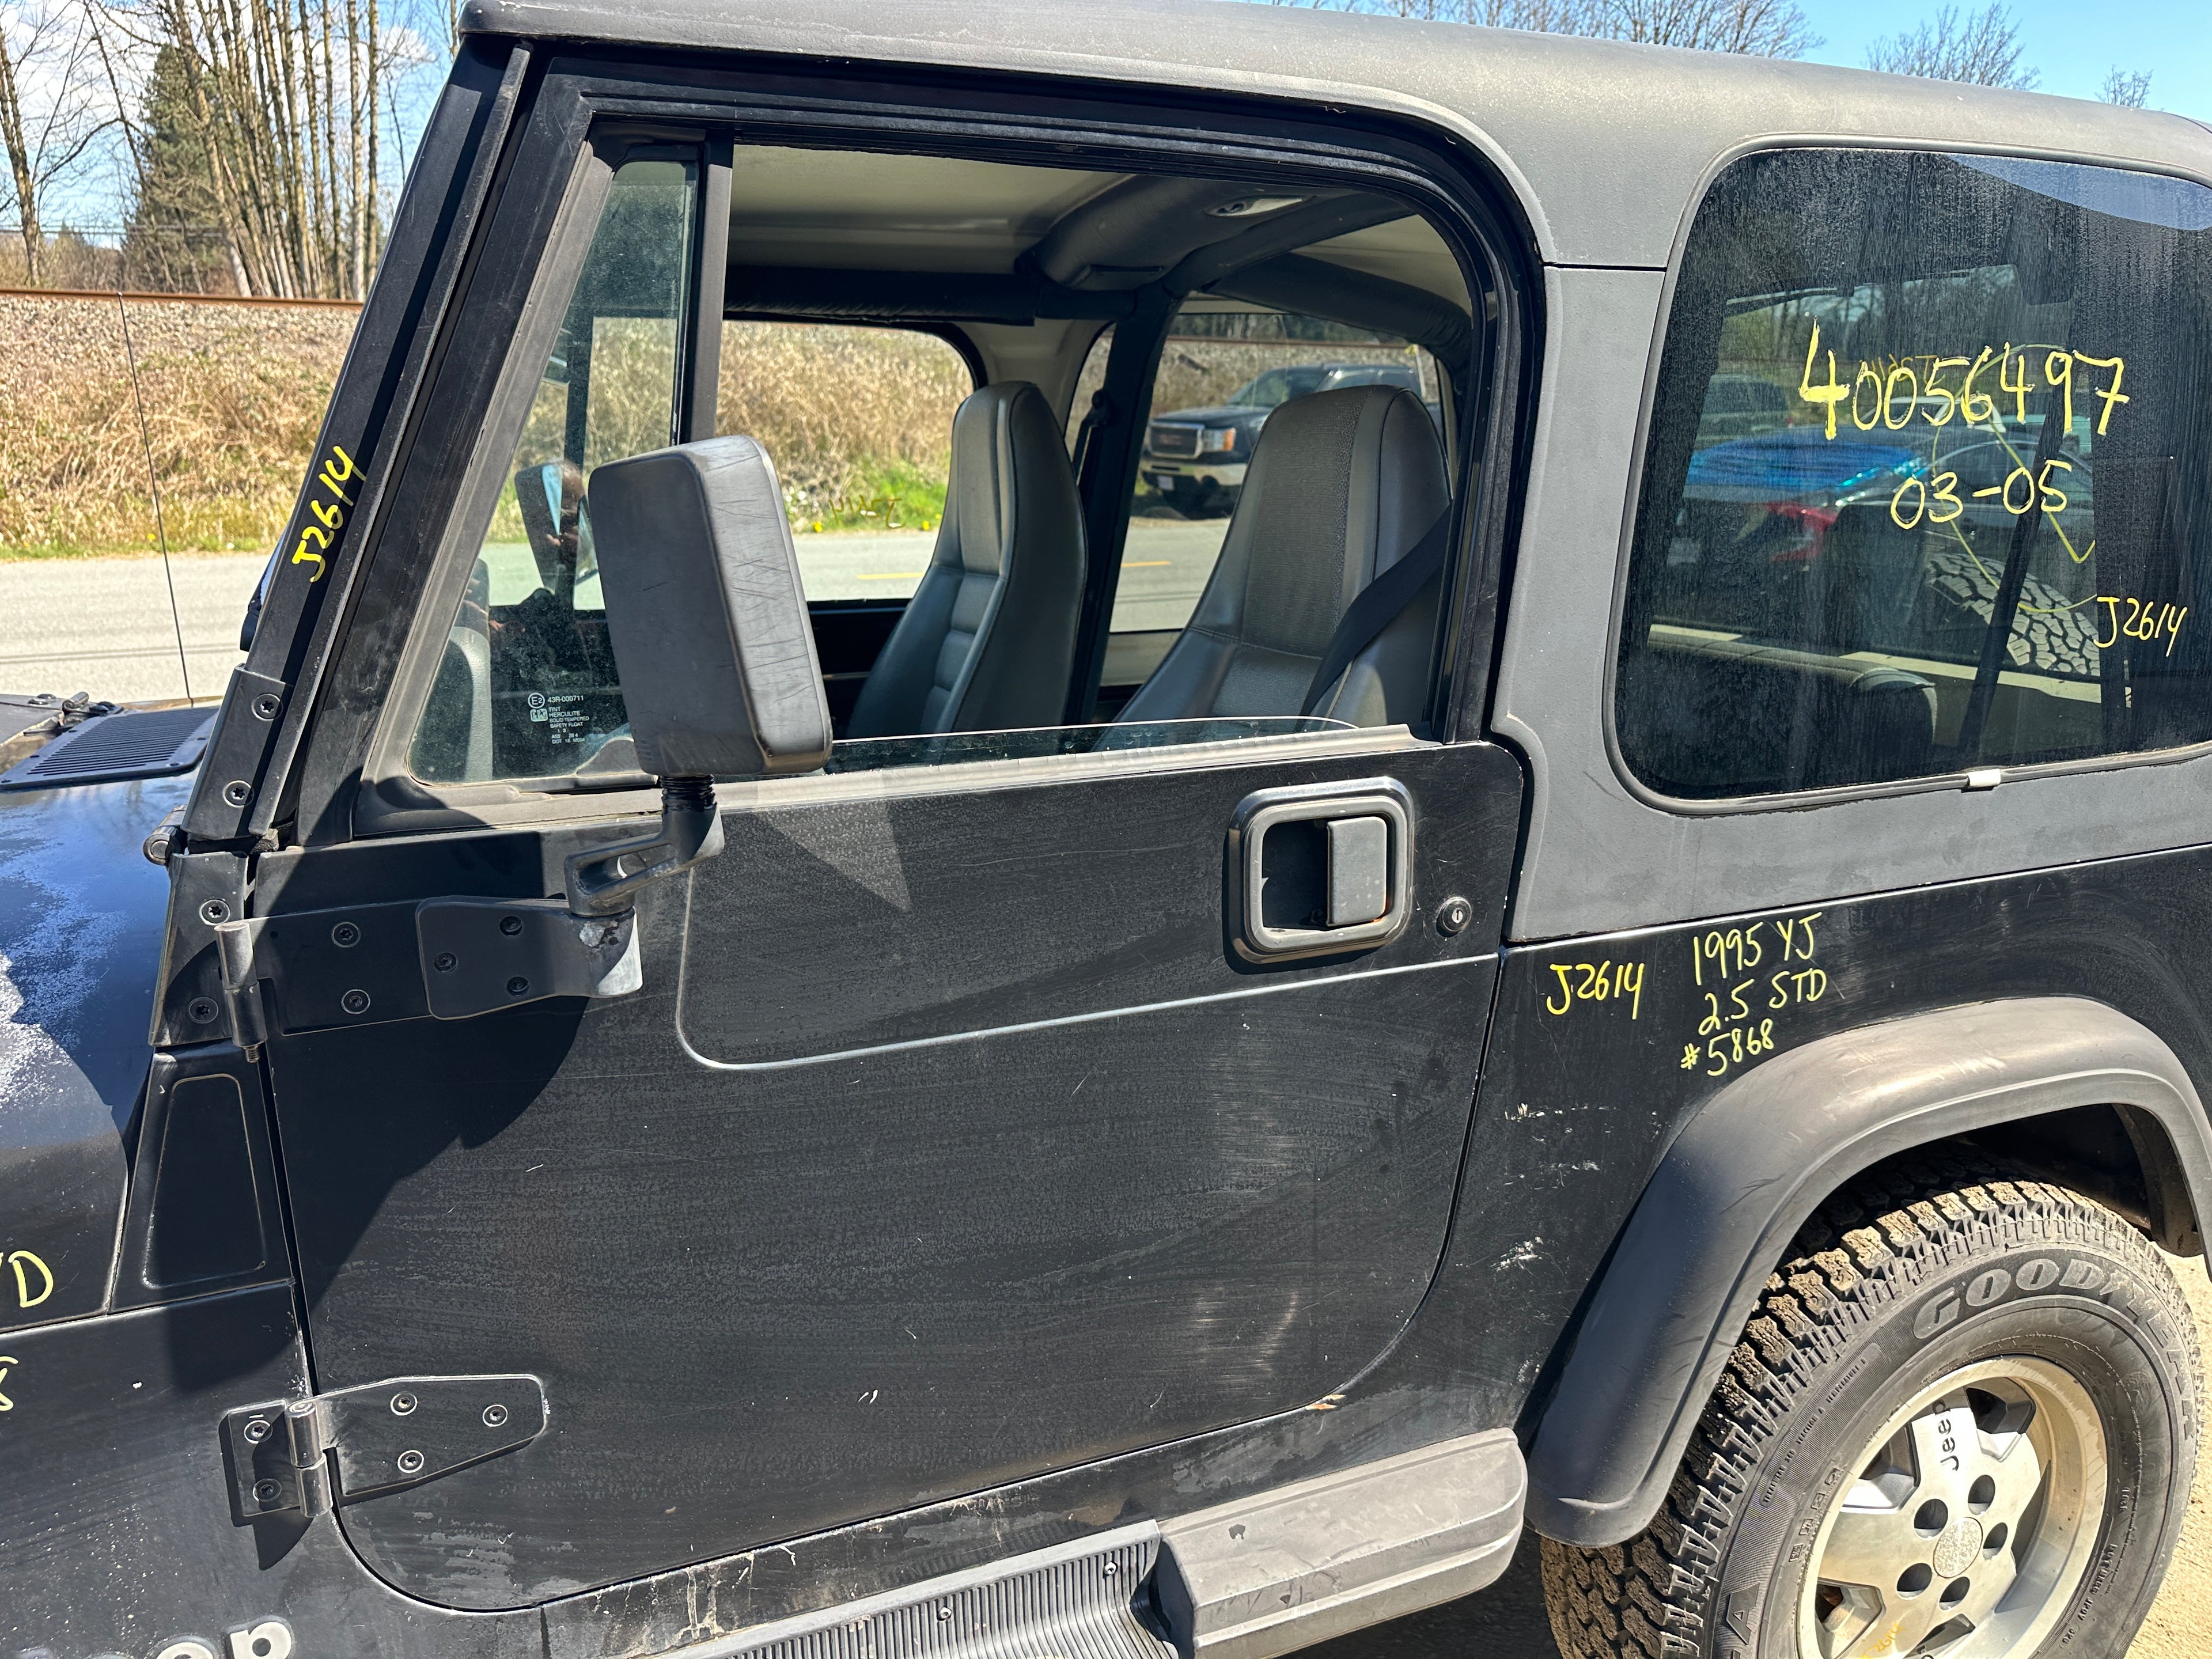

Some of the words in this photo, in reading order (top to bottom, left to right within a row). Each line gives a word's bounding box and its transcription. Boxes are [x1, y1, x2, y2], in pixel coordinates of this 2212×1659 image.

[1798, 316, 2131, 440] 40056497
[291, 446, 366, 582] J2614
[1891, 459, 2073, 529] 03-05
[2093, 596, 2188, 657] J2614
[1694, 921, 1764, 986] 1995
[1777, 911, 1822, 961] YJ
[1547, 960, 1645, 1020] J2614
[1698, 979, 1755, 1036] 2.5
[1768, 968, 1827, 1009] STD
[0, 1250, 54, 1308] D
[1912, 1257, 2196, 1441] GOODYEAR
[1931, 1399, 1960, 1472] Jeep
